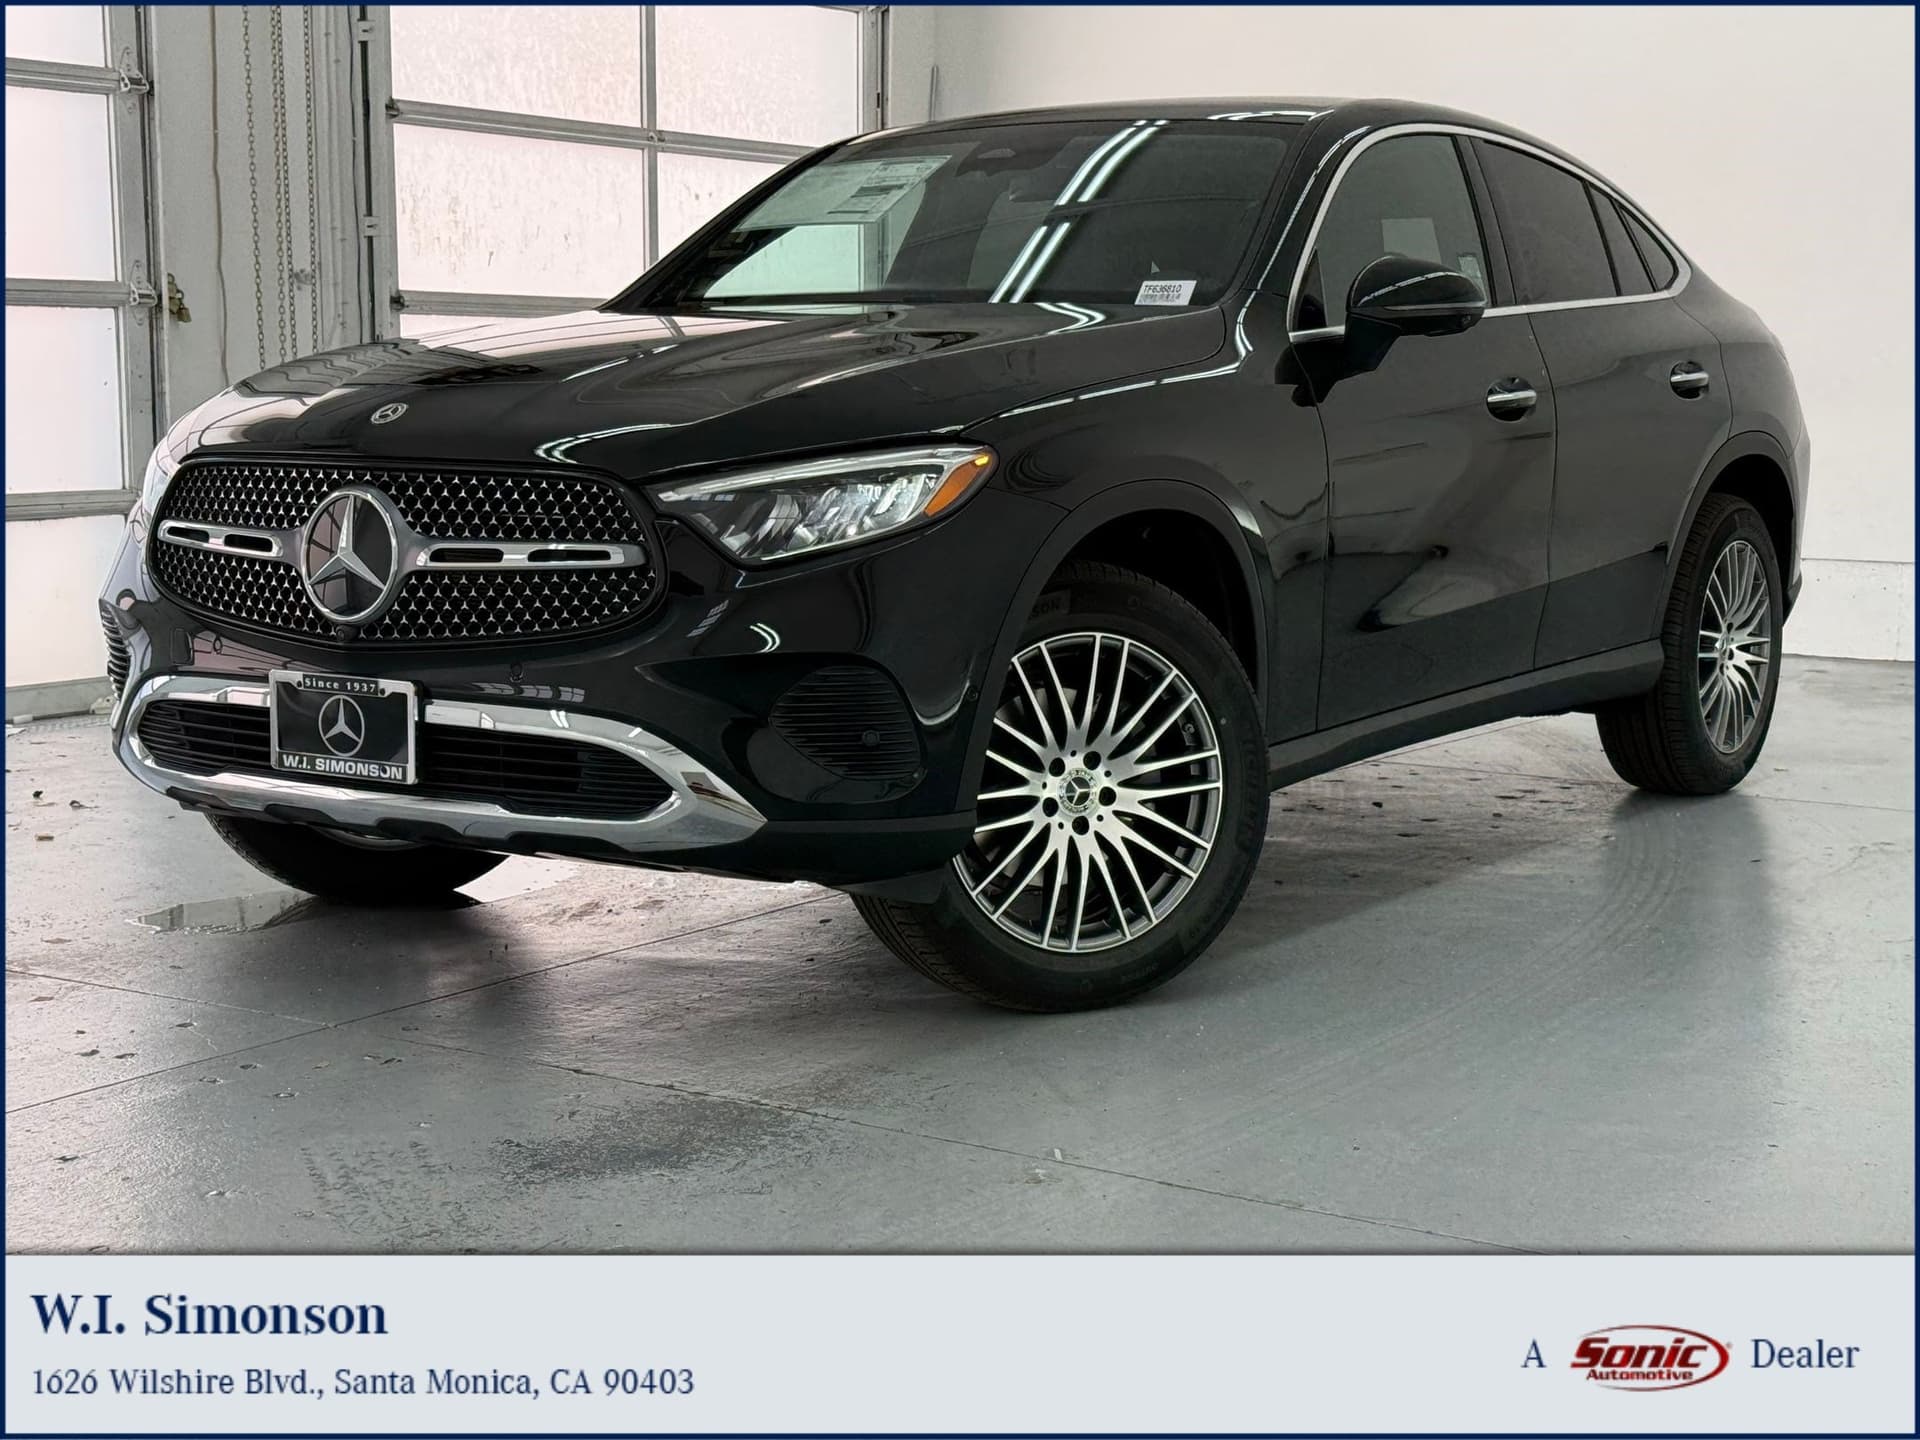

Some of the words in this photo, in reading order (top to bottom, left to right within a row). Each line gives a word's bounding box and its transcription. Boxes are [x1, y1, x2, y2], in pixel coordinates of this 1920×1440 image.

[304, 677, 340, 690] Since
[345, 681, 377, 693] 1937
[282, 754, 311, 770] W.I.
[315, 758, 403, 780] SIMONSON
